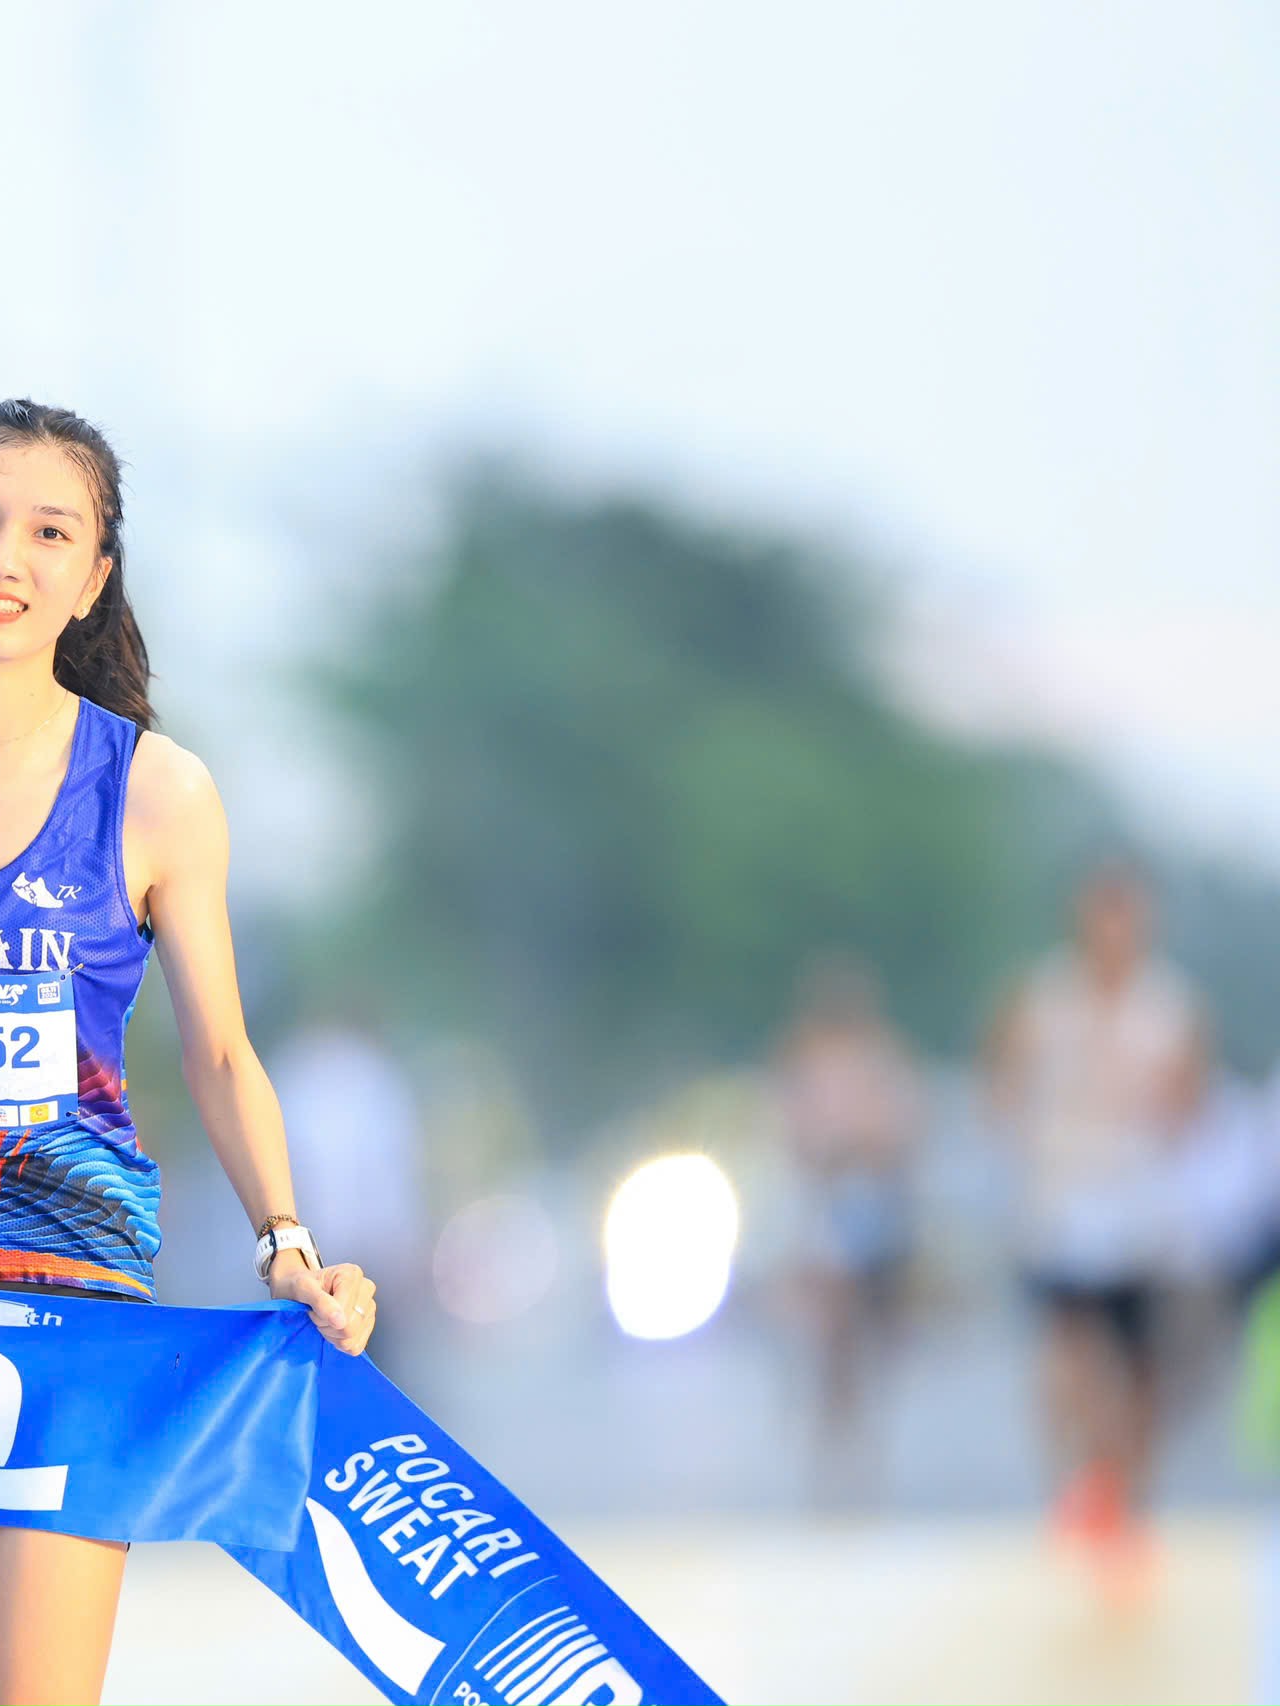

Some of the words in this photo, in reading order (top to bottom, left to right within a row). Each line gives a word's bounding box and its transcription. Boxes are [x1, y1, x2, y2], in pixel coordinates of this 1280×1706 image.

[56, 884, 82, 900] TK
[323, 1451, 479, 1601] SWEAT
[369, 1433, 540, 1579] POCARI
